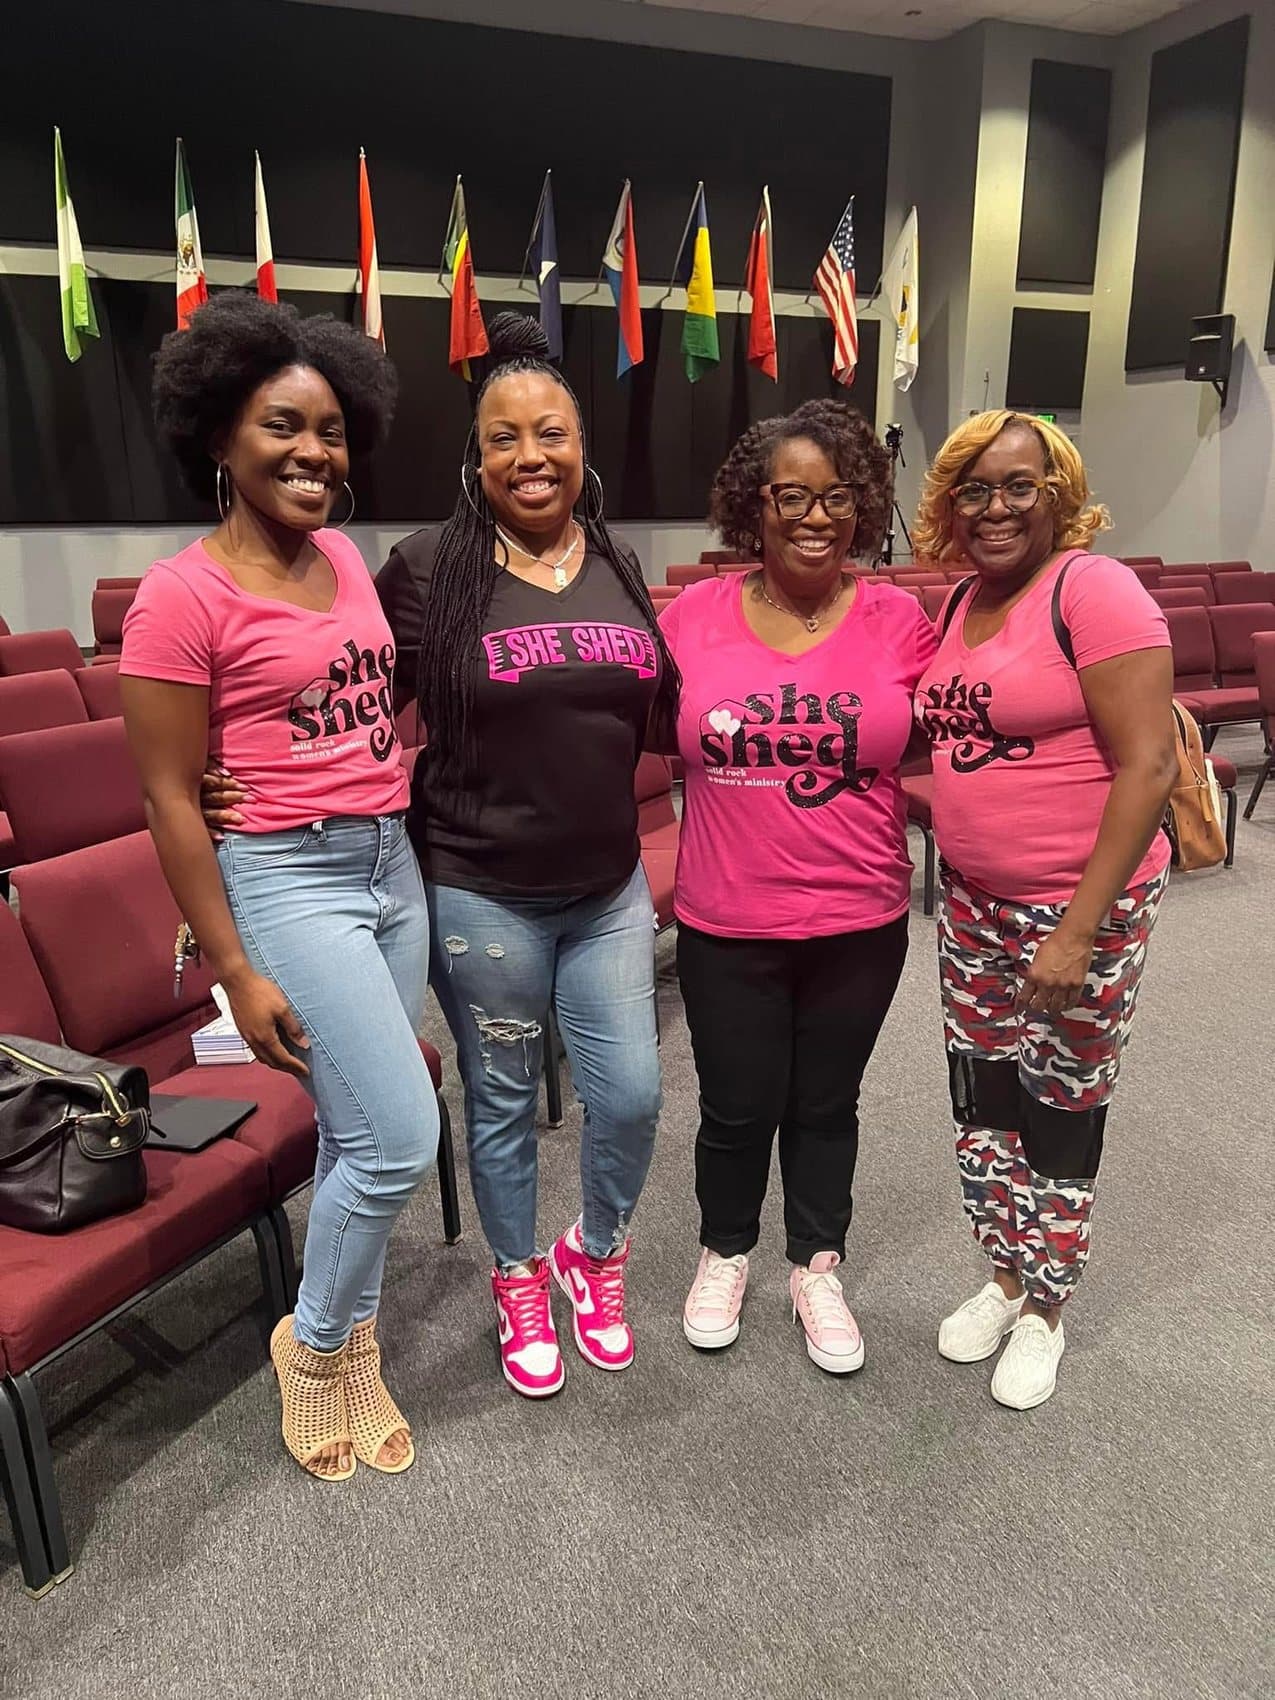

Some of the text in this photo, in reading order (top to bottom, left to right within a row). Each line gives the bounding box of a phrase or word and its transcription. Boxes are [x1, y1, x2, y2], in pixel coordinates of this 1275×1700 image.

[328, 639, 395, 693] she
[505, 627, 646, 666] SHE SHED
[741, 682, 863, 726] she
[924, 674, 992, 711] she
[287, 685, 398, 763] shed
[290, 741, 313, 752] solid
[700, 719, 880, 809] shed
[706, 767, 747, 777] solid rock
[707, 776, 786, 788] women's ministry
